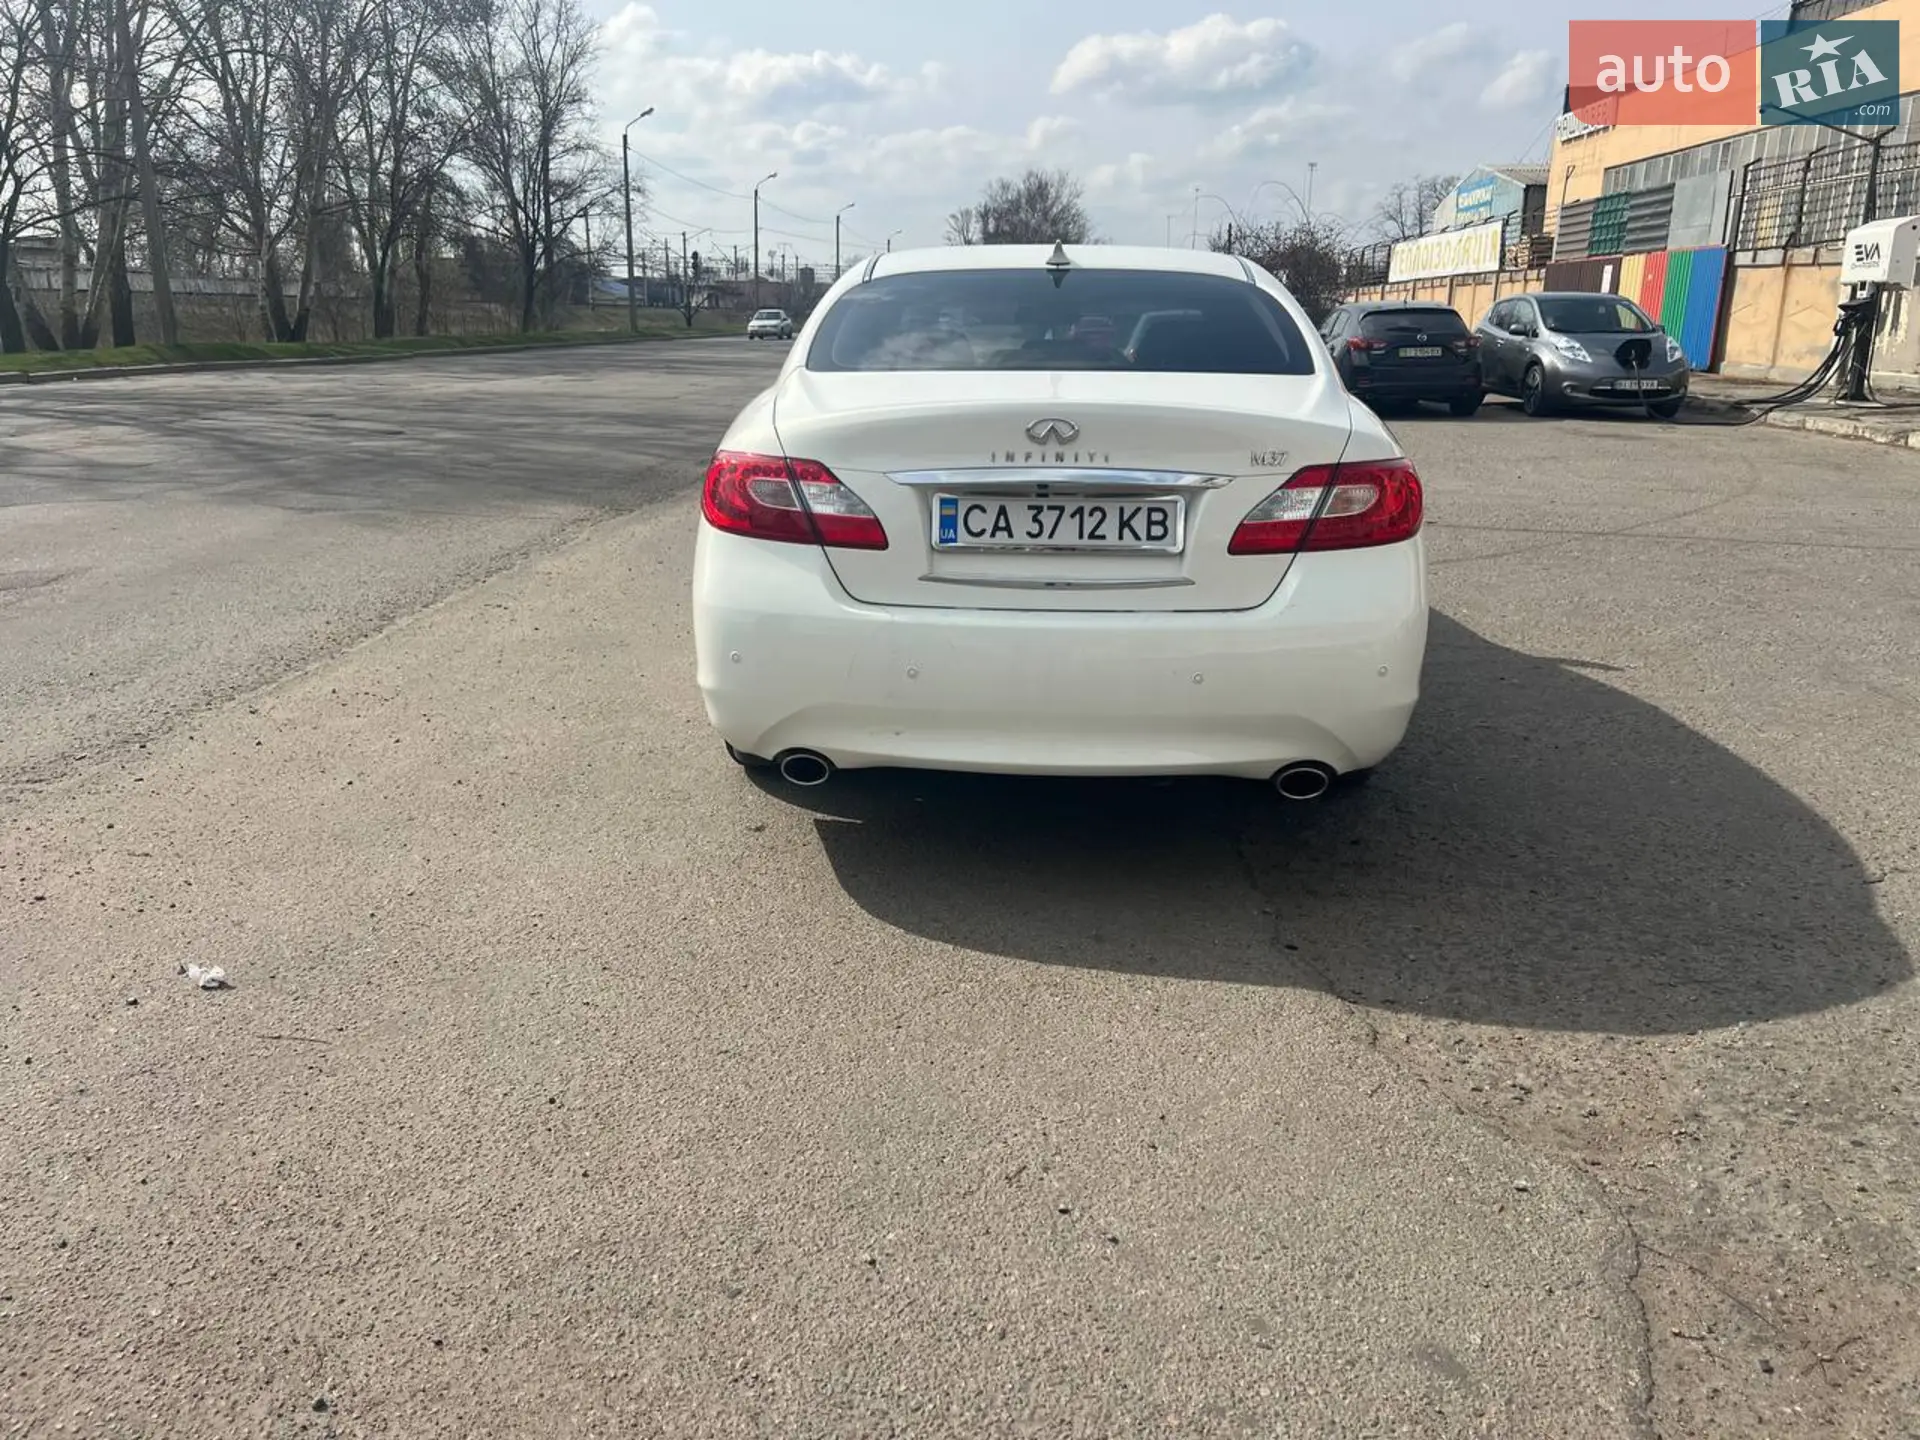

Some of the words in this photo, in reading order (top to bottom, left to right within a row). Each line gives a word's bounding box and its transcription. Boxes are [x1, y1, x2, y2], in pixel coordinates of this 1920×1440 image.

[1854, 242, 1881, 262] EVA
[990, 452, 1110, 464] INFINITI
[1250, 450, 1288, 467] M37
[962, 504, 1014, 539] CA
[1026, 505, 1107, 540] 3712
[1118, 506, 1169, 541] KB
[940, 529, 956, 539] UA
